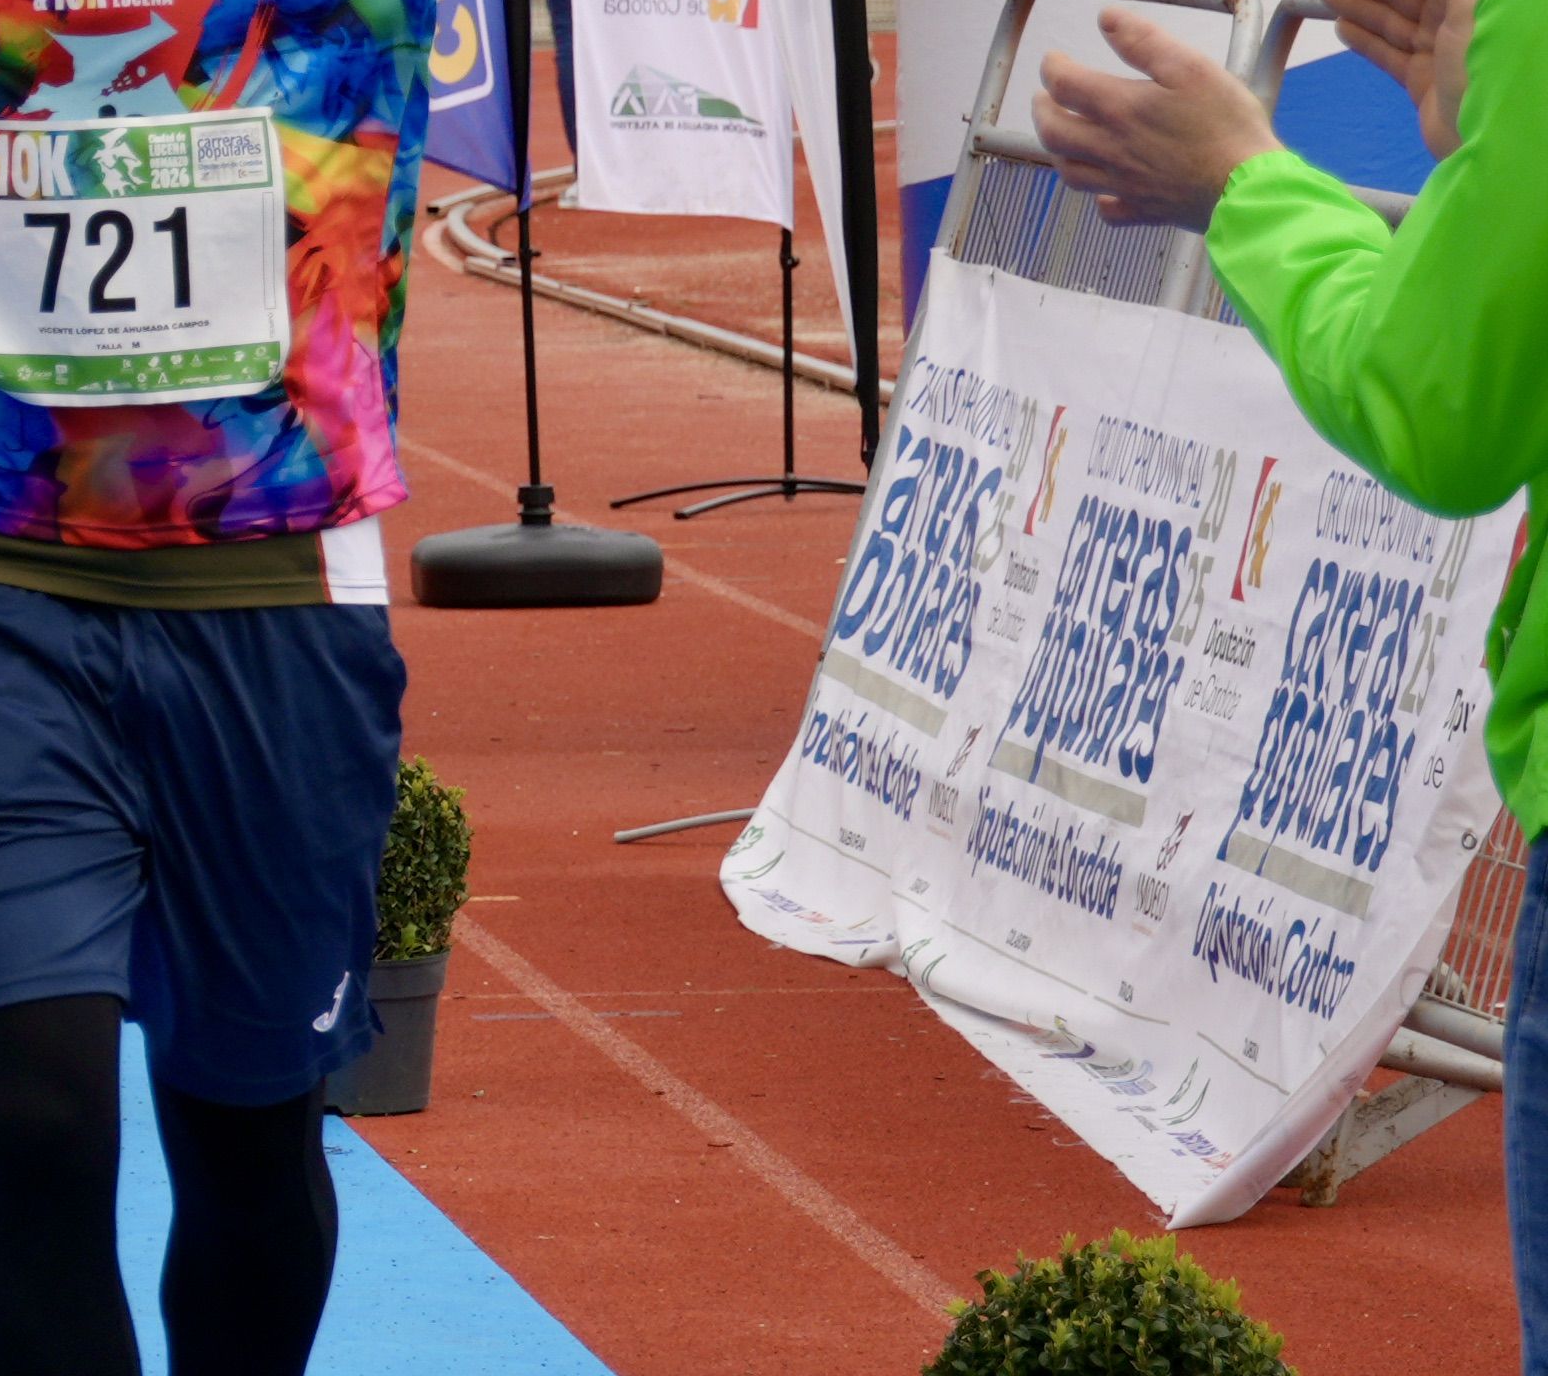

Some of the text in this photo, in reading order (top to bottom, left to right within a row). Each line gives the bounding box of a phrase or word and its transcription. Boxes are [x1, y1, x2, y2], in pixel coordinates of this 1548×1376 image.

[197, 134, 250, 149] carreras
[197, 143, 262, 163] populares
[23, 206, 192, 313] 721
[1197, 448, 1237, 544] 20
[1055, 493, 1215, 651] carreras 25
[990, 609, 1185, 784] populares
[1281, 556, 1425, 723] carreras
[1216, 685, 1416, 877] populares
